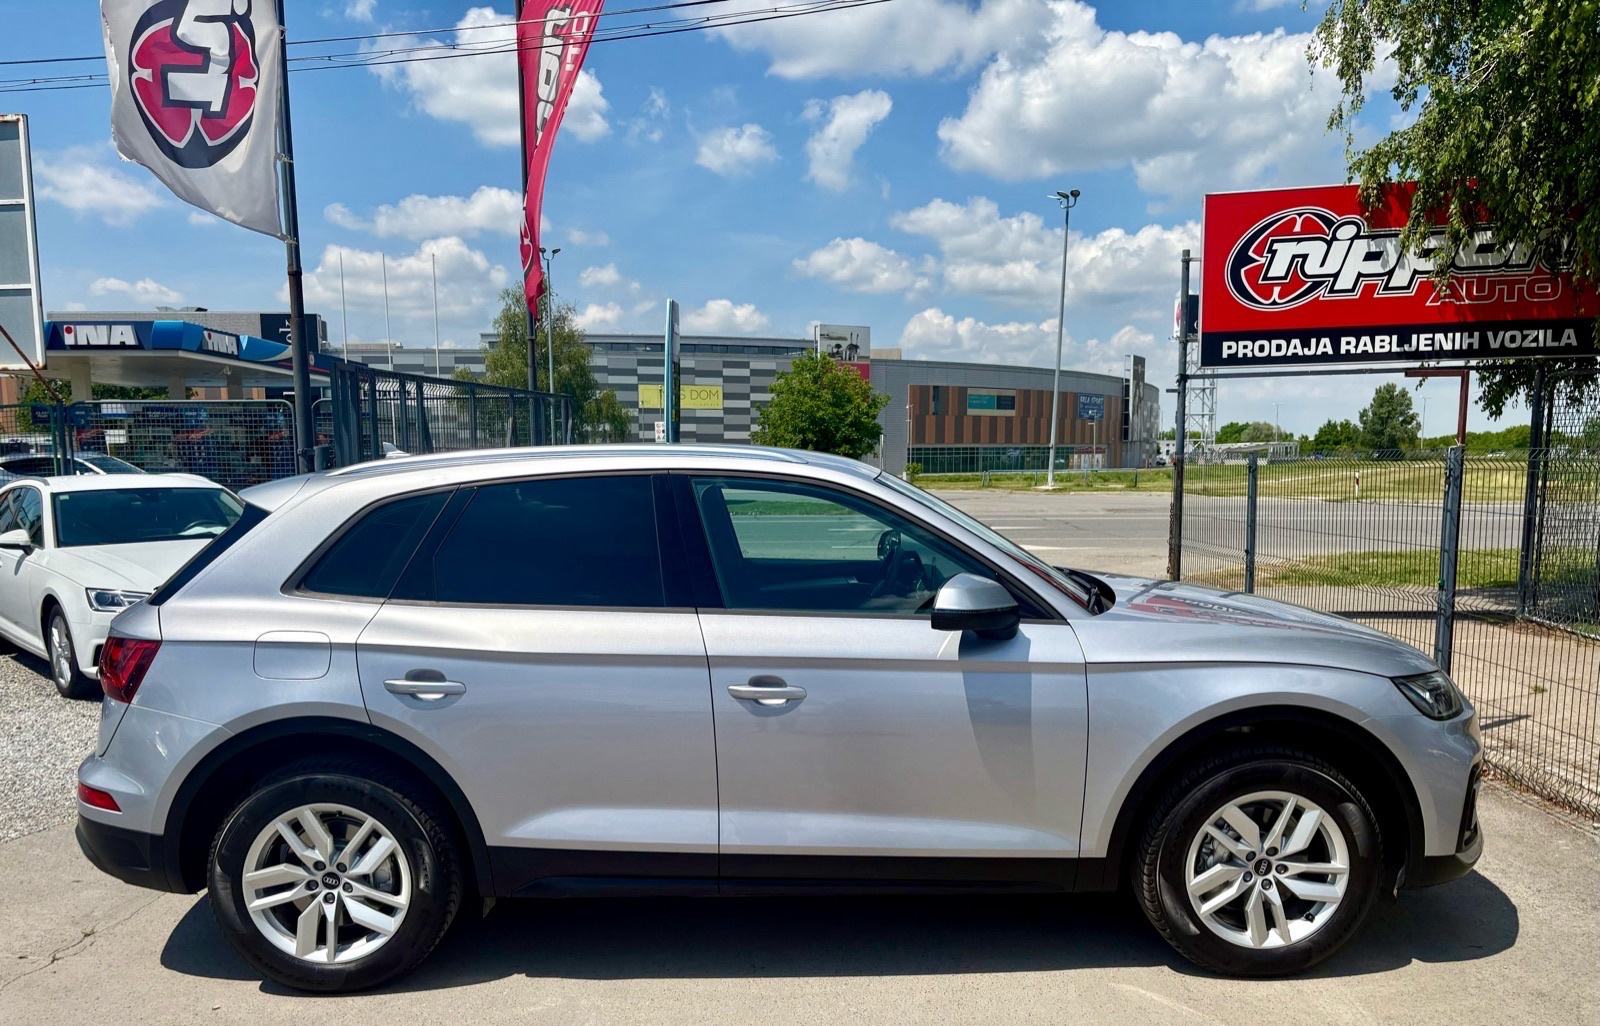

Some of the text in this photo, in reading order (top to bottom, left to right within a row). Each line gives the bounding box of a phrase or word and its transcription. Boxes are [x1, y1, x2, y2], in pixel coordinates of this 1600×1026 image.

[1427, 274, 1562, 305] AUTO
[1222, 328, 1577, 359] PRODAJA RABLJENIH VOZILA
[690, 389, 719, 401] DOM
